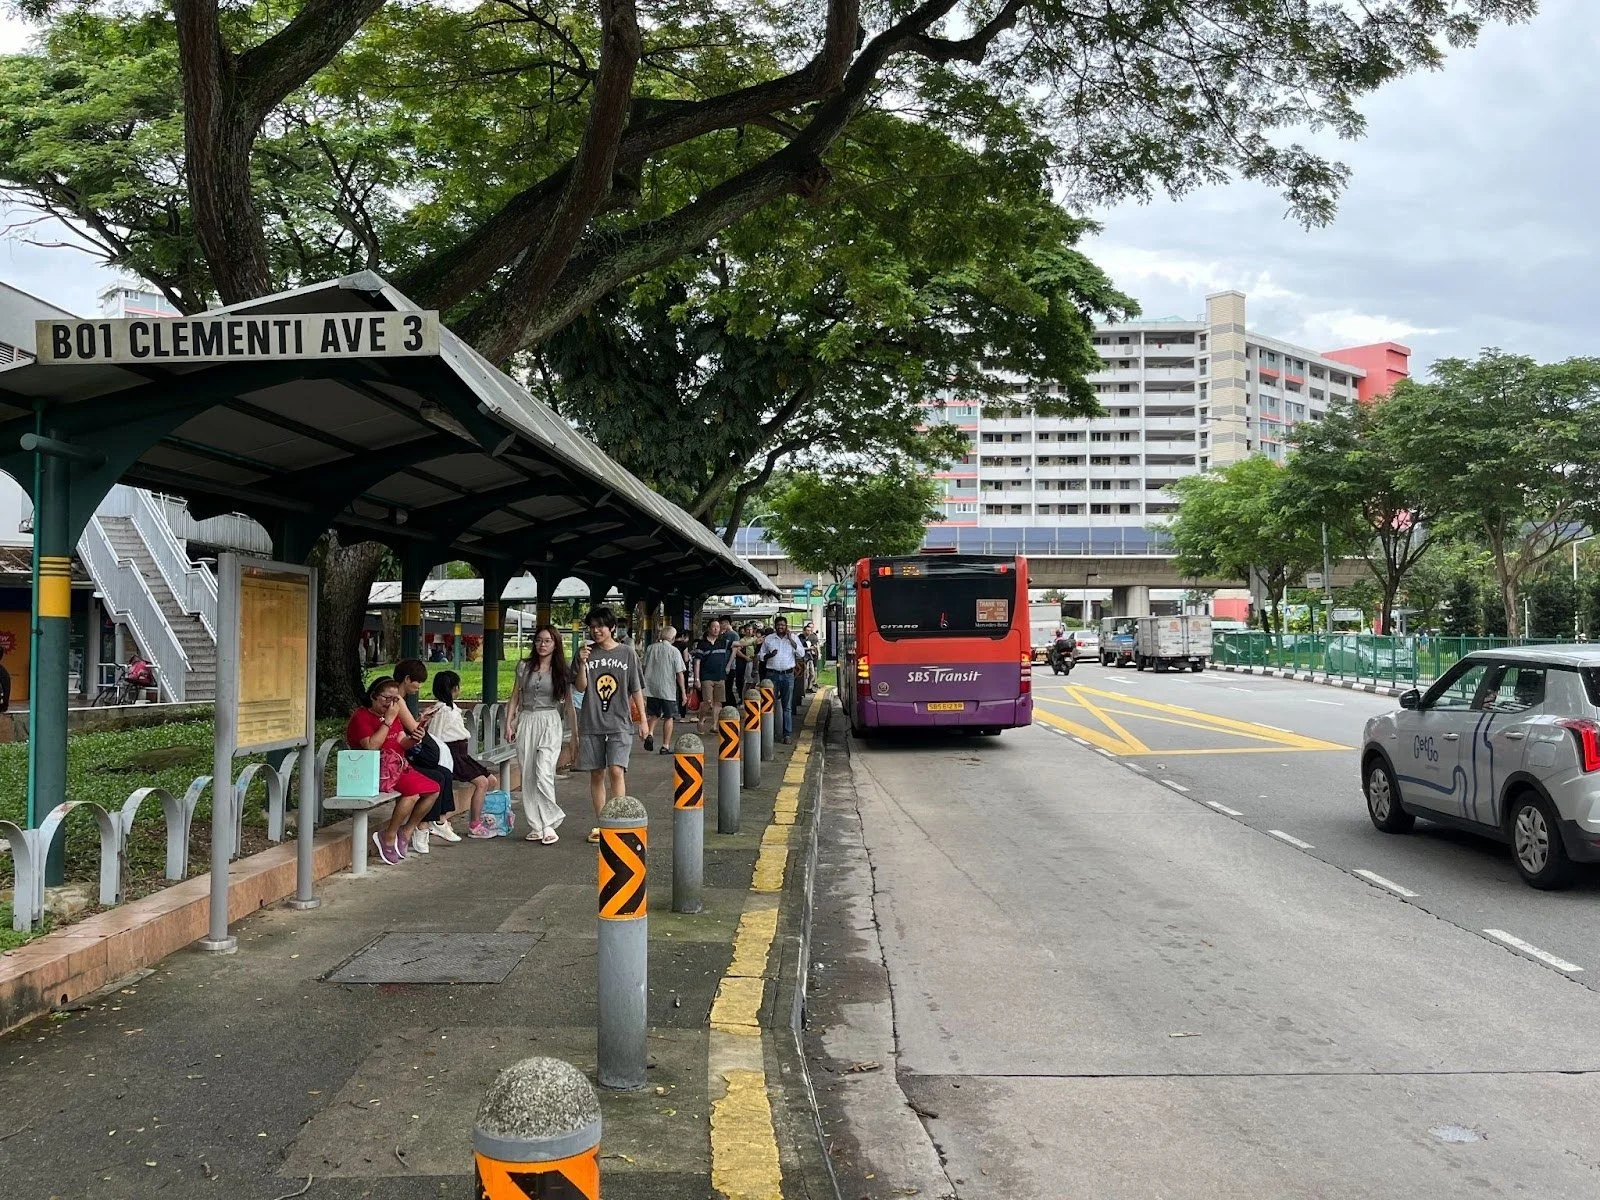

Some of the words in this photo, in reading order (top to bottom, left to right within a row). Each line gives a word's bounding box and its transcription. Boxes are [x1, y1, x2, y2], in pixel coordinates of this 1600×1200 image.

[129, 319, 303, 358] CLEMENTI
[320, 317, 387, 353] AVE
[402, 314, 424, 352] 3
[907, 671, 930, 683] SBS
[929, 668, 982, 684] Transit
[1414, 735, 1438, 762] GetGo
